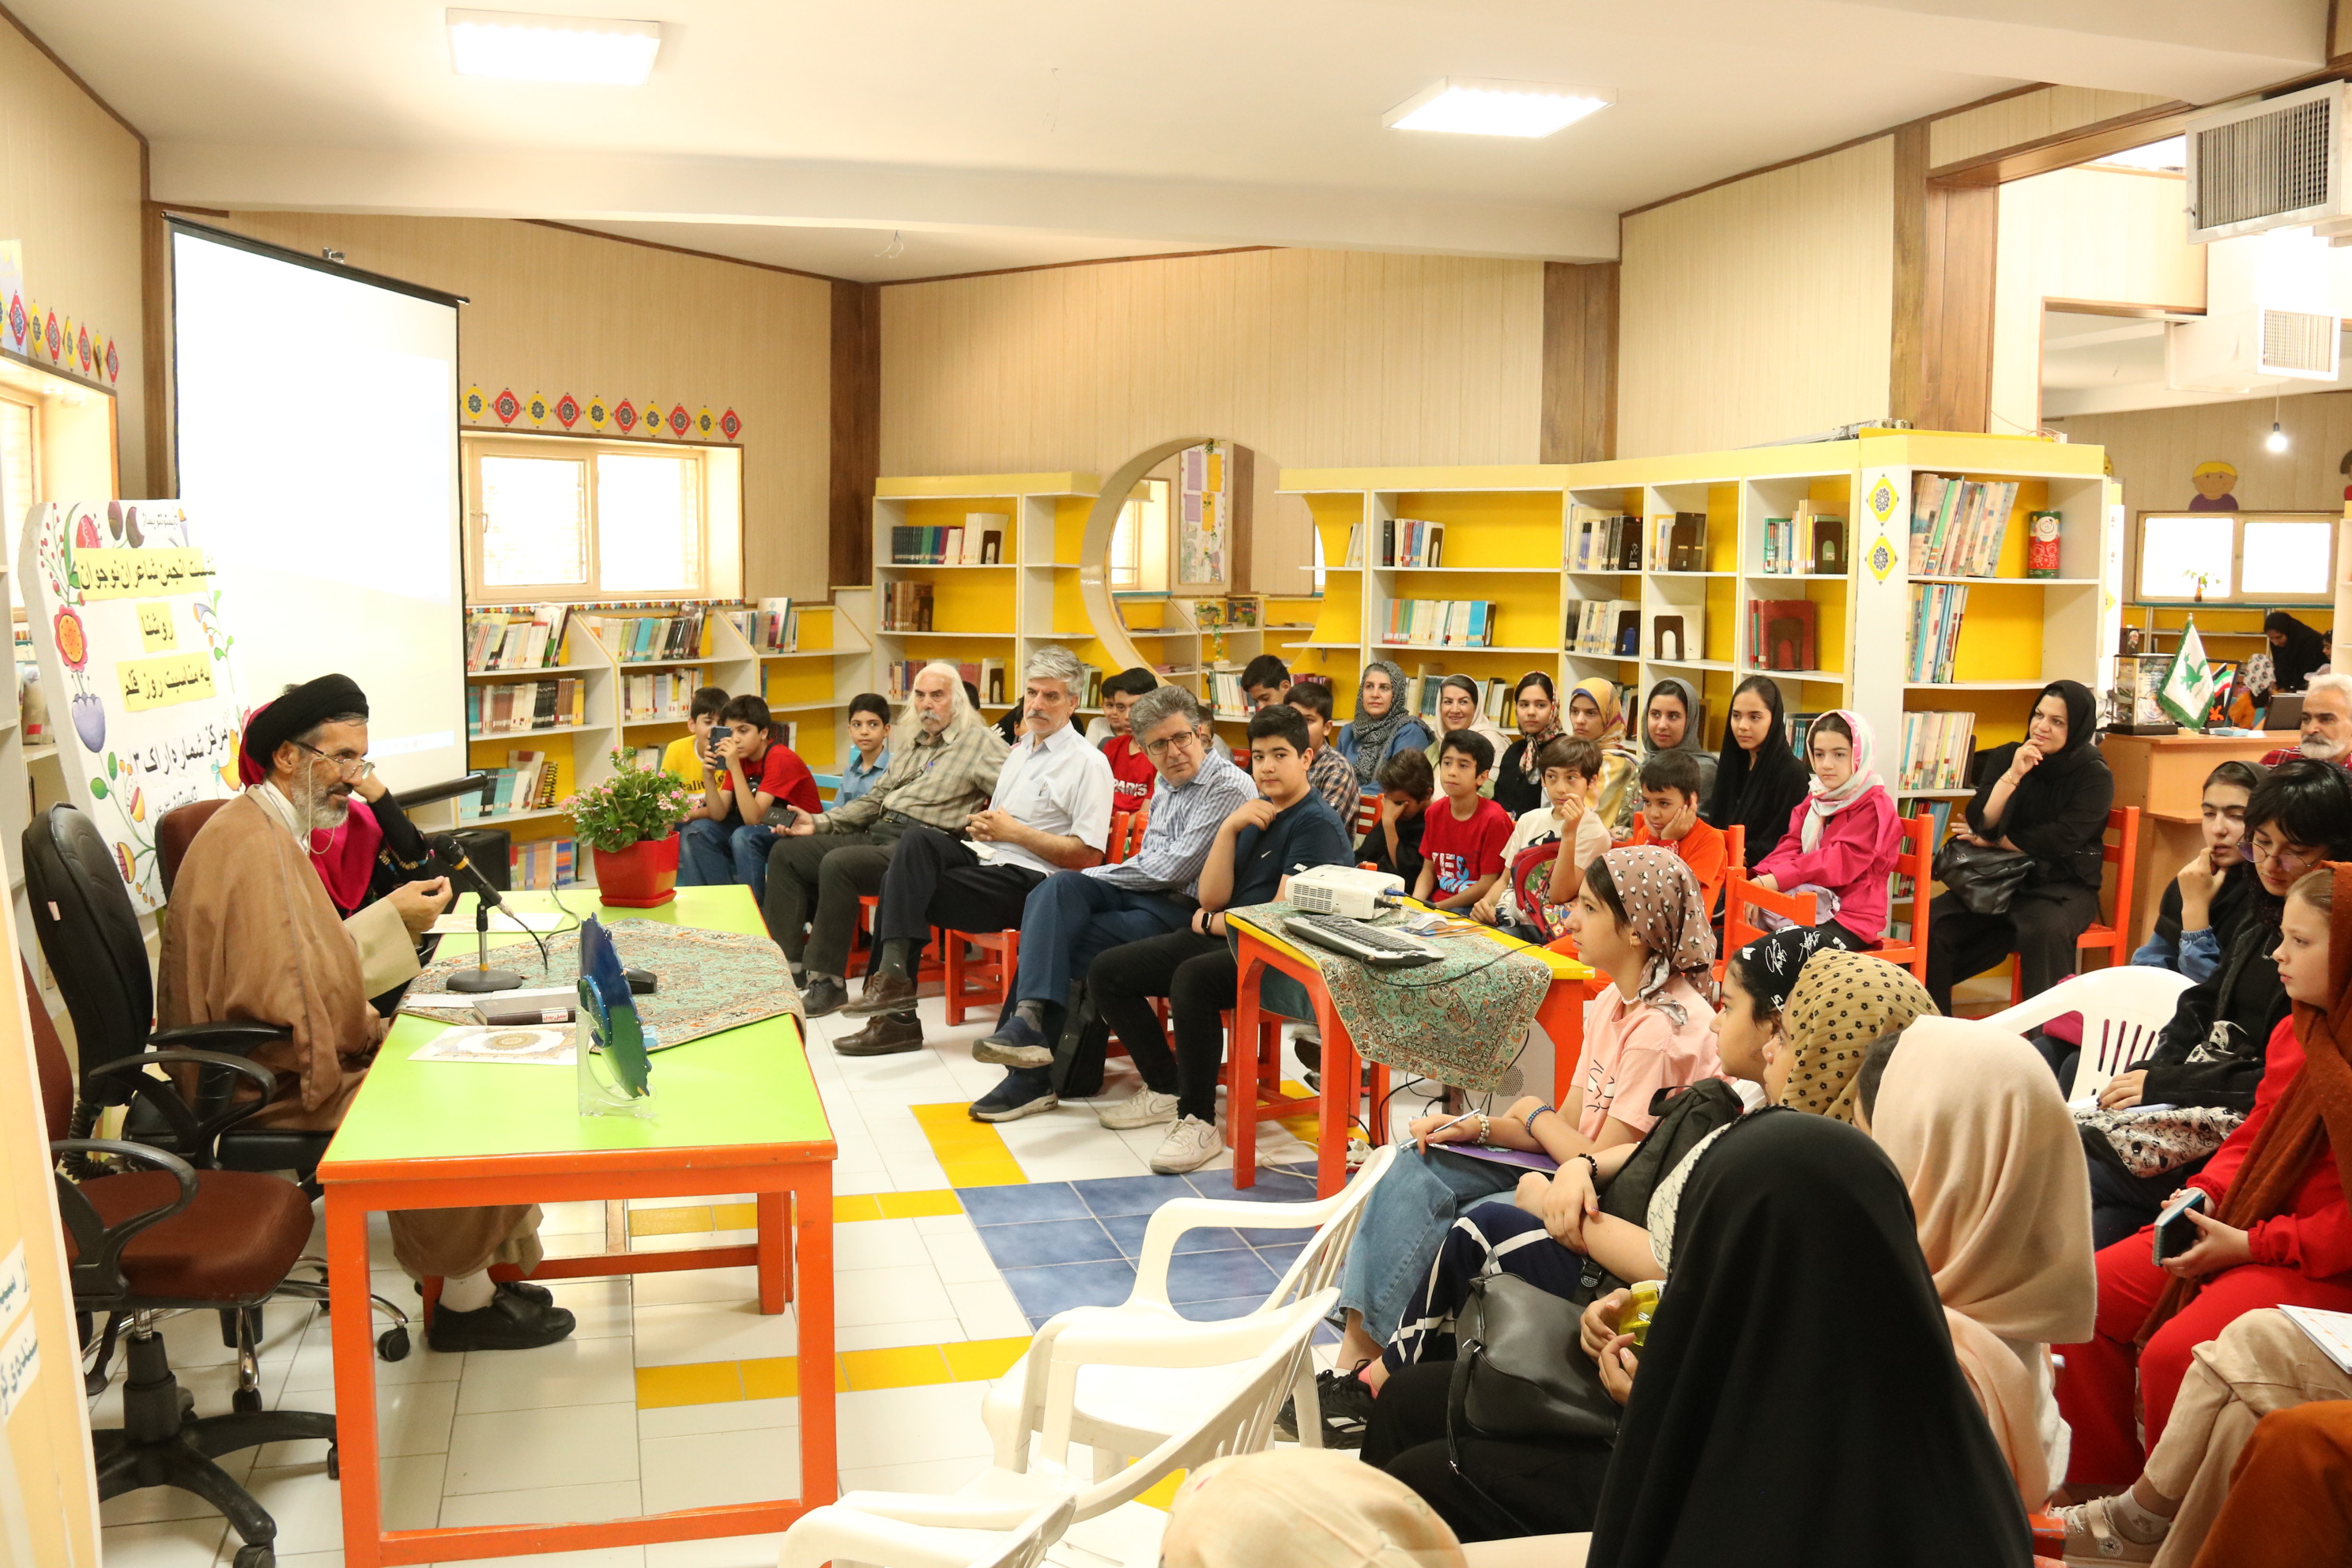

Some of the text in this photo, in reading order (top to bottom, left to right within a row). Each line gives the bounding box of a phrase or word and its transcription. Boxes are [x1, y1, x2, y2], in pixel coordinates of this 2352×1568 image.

[81, 556, 216, 590] نشست انجمن شاعران نوجوان
[141, 612, 174, 641] روشنا
[125, 664, 211, 708] به مناسبت روز قلم
[172, 732, 205, 770] شماره
[205, 723, 228, 756] مرکز
[144, 740, 172, 775] اراک
[1114, 778, 1148, 797] PARIS
[1432, 852, 1470, 880] YES
